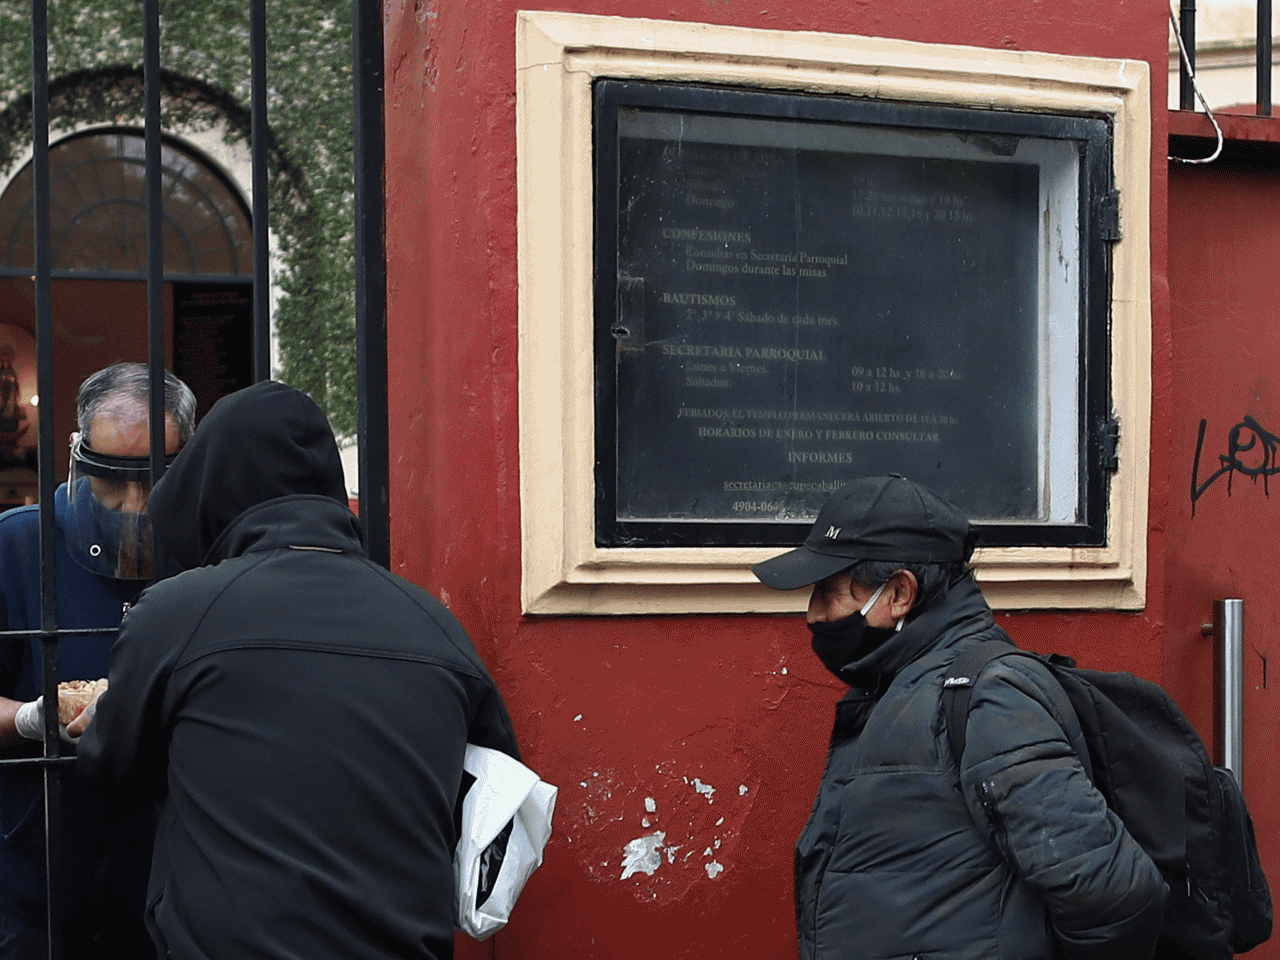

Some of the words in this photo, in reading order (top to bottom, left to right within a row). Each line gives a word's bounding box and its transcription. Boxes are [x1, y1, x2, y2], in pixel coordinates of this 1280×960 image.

[663, 228, 751, 243] CONFESIONES
[736, 251, 747, 260] en
[799, 251, 848, 268] Parroquial
[686, 260, 739, 275] Domingos
[742, 263, 780, 275] durante
[783, 265, 796, 276] las
[663, 293, 736, 306] BAUTISMOS
[737, 311, 774, 324] Sábado
[777, 312, 789, 324] de
[792, 314, 815, 325] cada
[745, 347, 825, 362] PARROQUIAL
[852, 366, 865, 377] 09
[866, 368, 872, 377] a
[876, 367, 887, 378] 12
[852, 380, 864, 392] 10
[865, 383, 872, 392] a
[875, 381, 886, 392] 12
[747, 409, 789, 419] TEMPLO
[862, 412, 904, 423] ABIERTO
[905, 413, 918, 423] DE
[698, 427, 756, 438] HORARIOS
[759, 428, 774, 438] DE
[776, 428, 813, 439] ENERO
[816, 430, 824, 440] Y
[825, 429, 874, 441] FEBRERO
[876, 430, 940, 442] CONSULTAR
[788, 452, 853, 463] INFORMES
[824, 524, 842, 540] M
